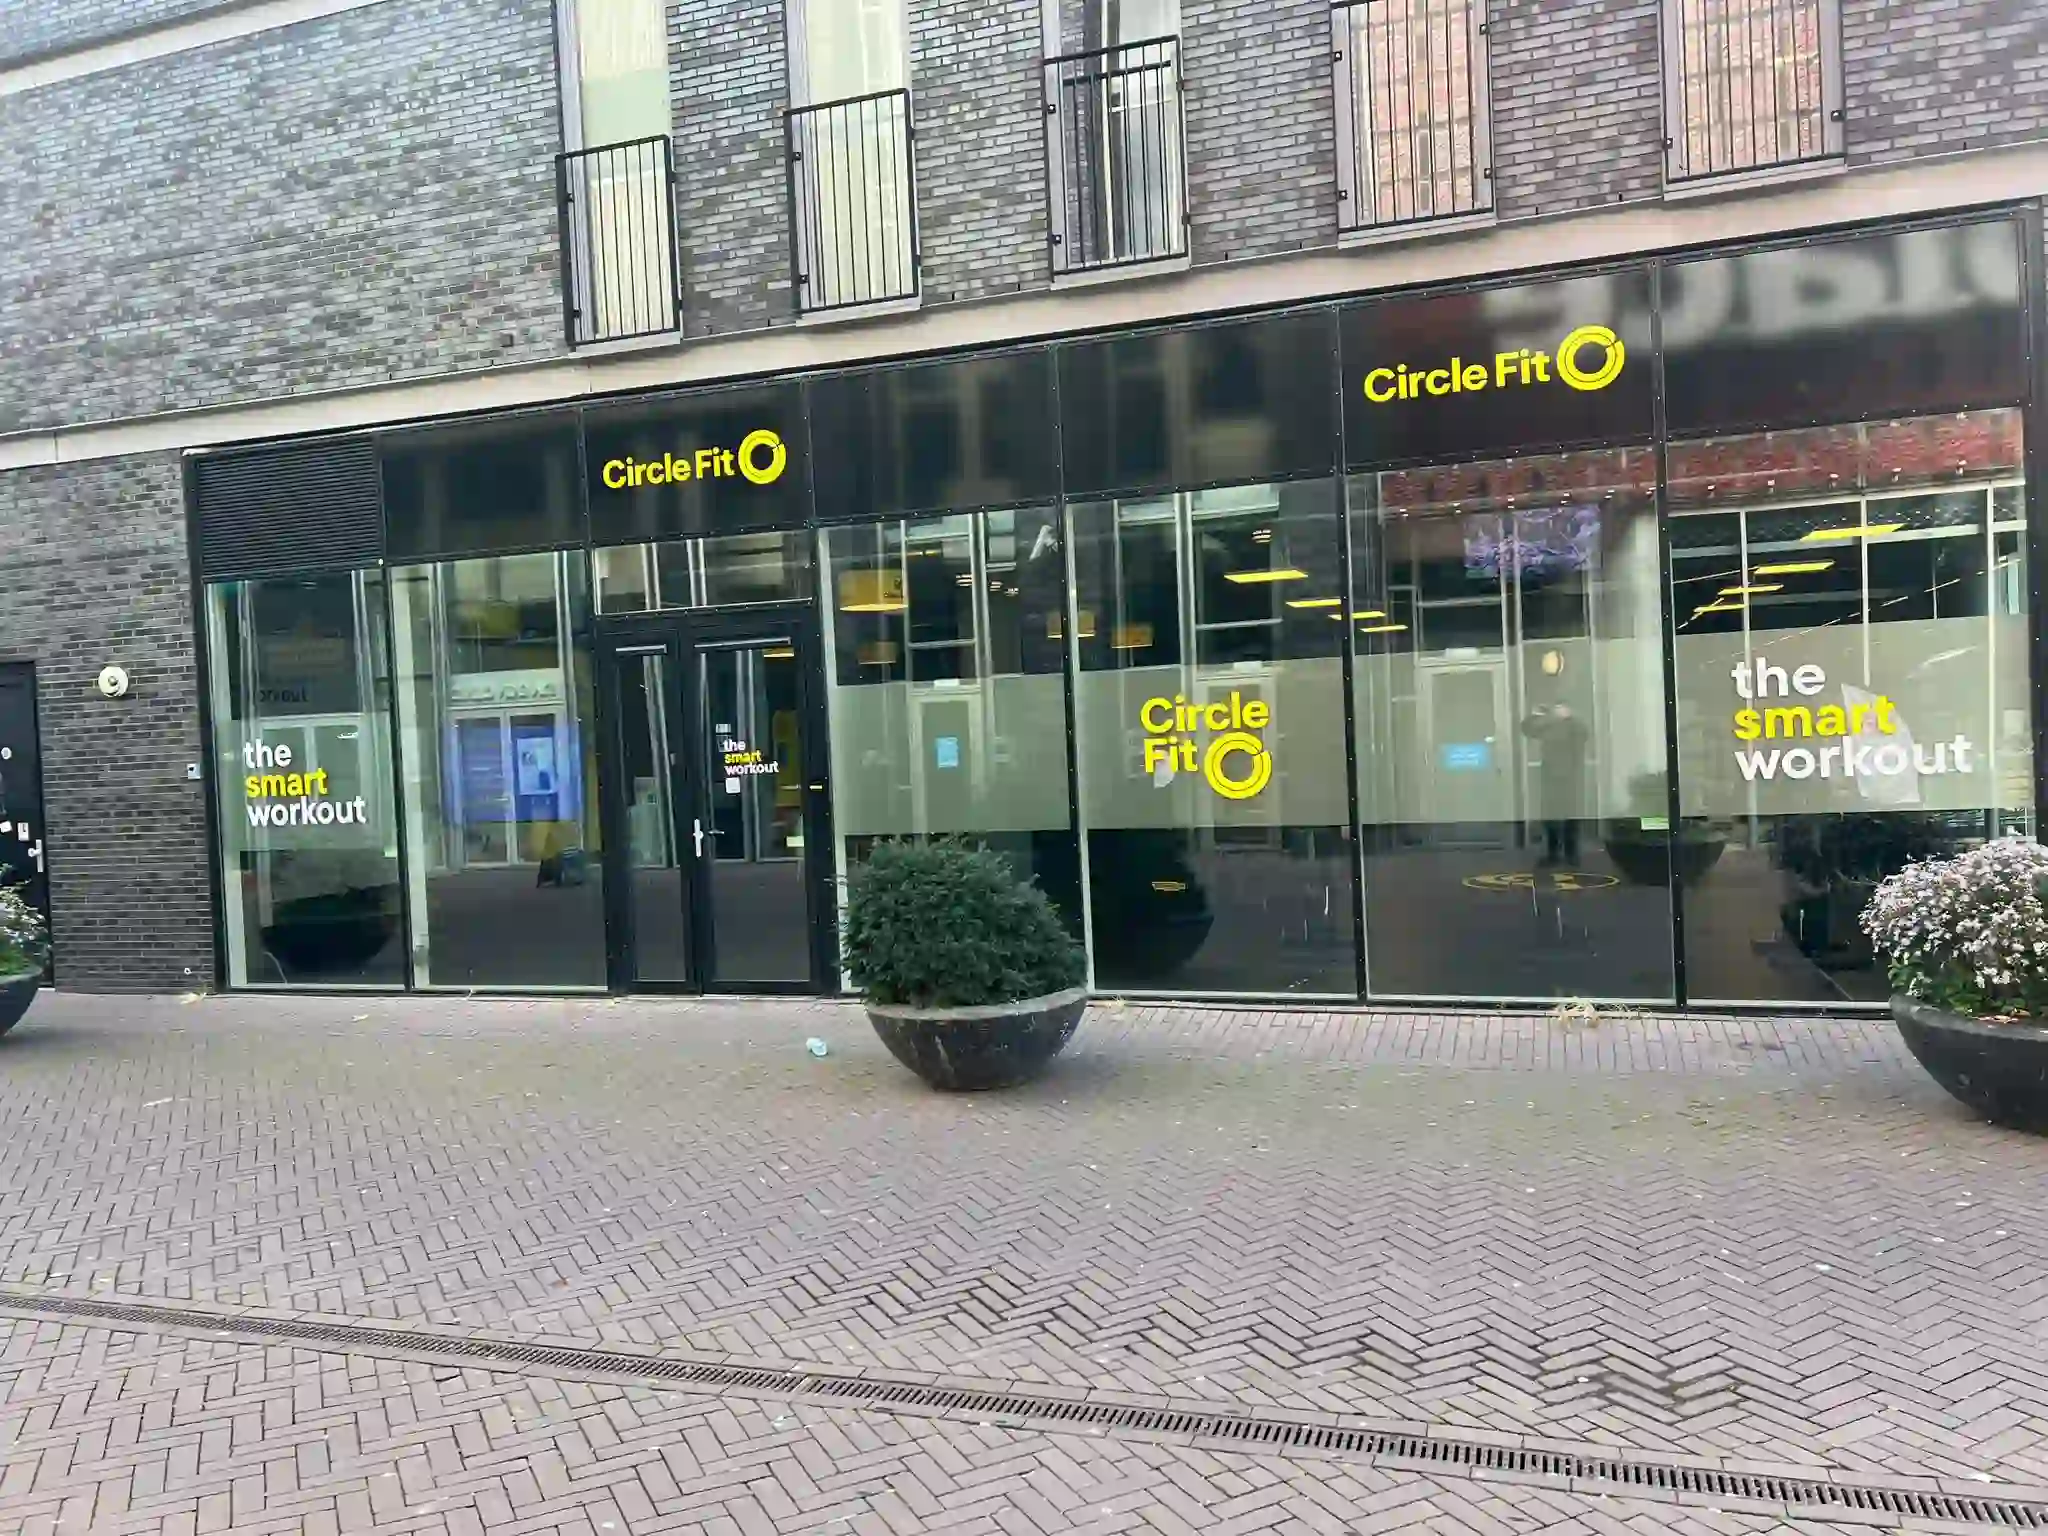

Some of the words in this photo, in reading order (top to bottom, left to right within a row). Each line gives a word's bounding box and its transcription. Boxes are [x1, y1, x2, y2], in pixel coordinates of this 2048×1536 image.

[1364, 358, 1489, 404] Circle
[1495, 348, 1552, 388] Fit
[602, 451, 693, 489] Circle
[695, 446, 736, 481] Fit
[1731, 656, 1827, 699] the
[1139, 691, 1270, 735] Circle
[1733, 695, 1898, 741] smart
[243, 739, 292, 769] the
[723, 739, 747, 752] the
[724, 749, 763, 764] smart
[1143, 735, 1199, 774] Fit
[1734, 734, 1974, 781] workout
[245, 767, 328, 798] smart
[724, 760, 780, 776] workout
[246, 795, 367, 828] workout
